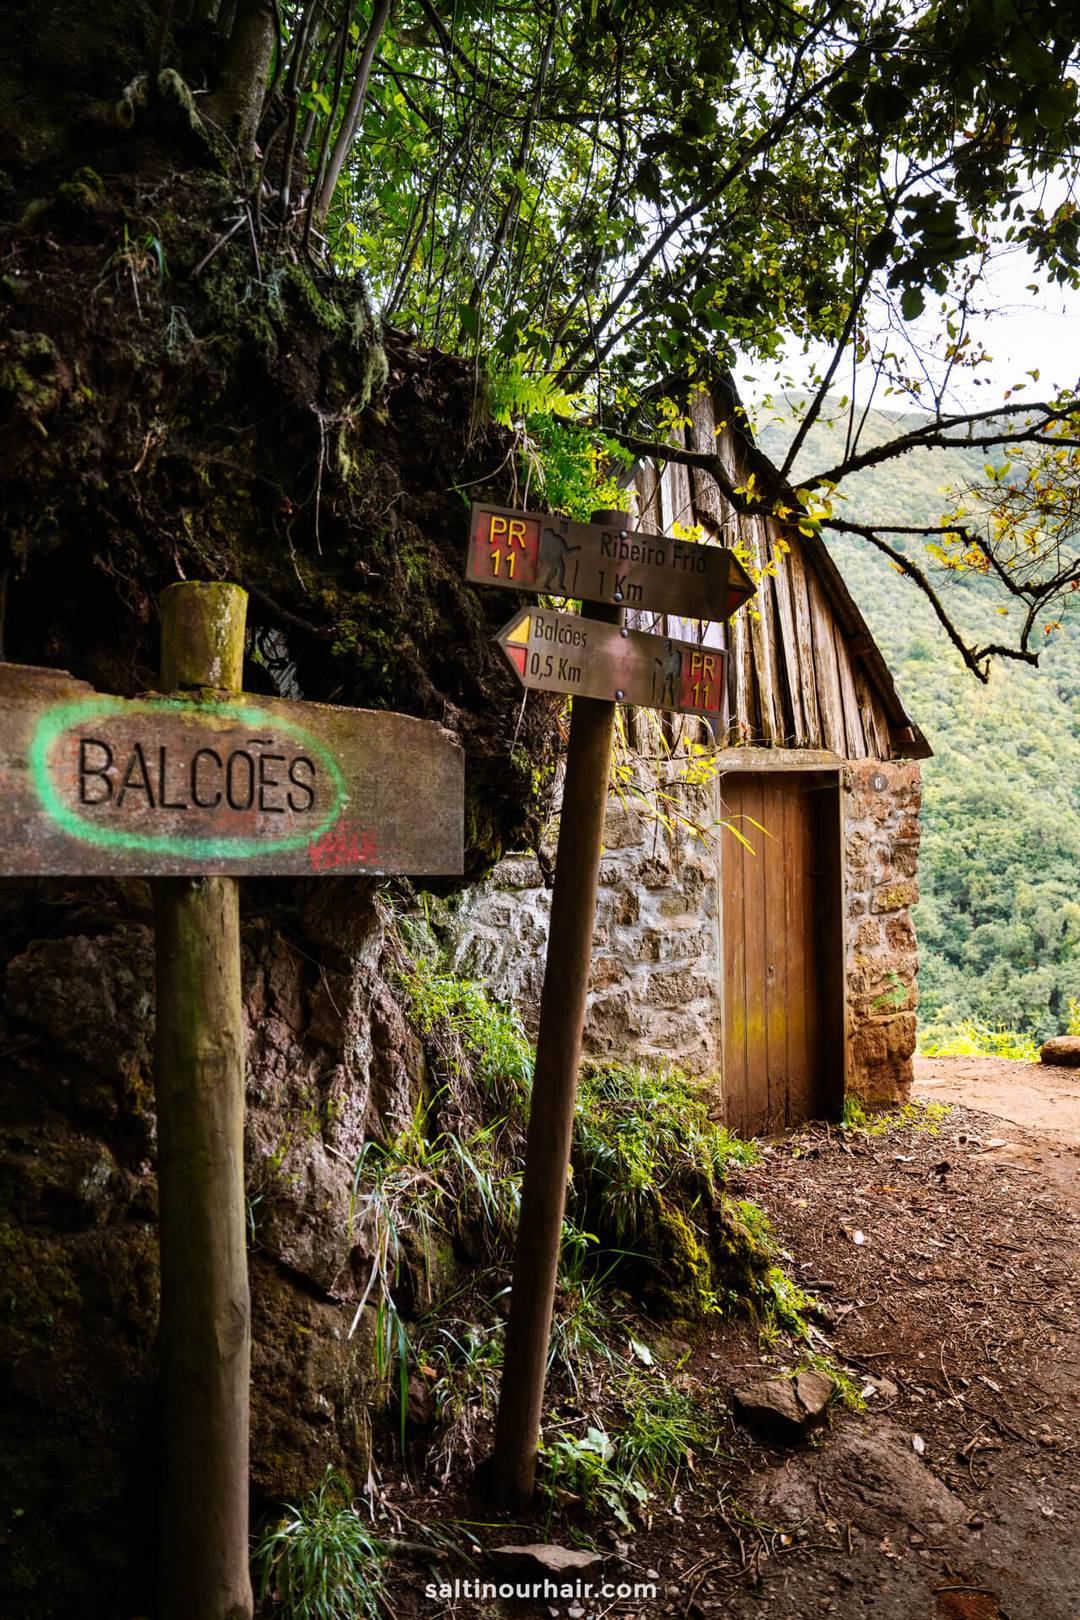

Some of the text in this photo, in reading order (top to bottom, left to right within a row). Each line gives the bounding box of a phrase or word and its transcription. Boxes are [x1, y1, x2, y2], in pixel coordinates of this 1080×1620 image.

[489, 515, 527, 550] PR
[490, 548, 516, 578] 11
[600, 531, 707, 573] Ribeiro Frio
[598, 571, 643, 602] 1 Km
[534, 615, 588, 648] Balcões
[530, 652, 581, 683] 0,5 Km
[690, 651, 716, 680] PR
[692, 682, 711, 708] 11
[77, 737, 316, 814] BALCÕES
